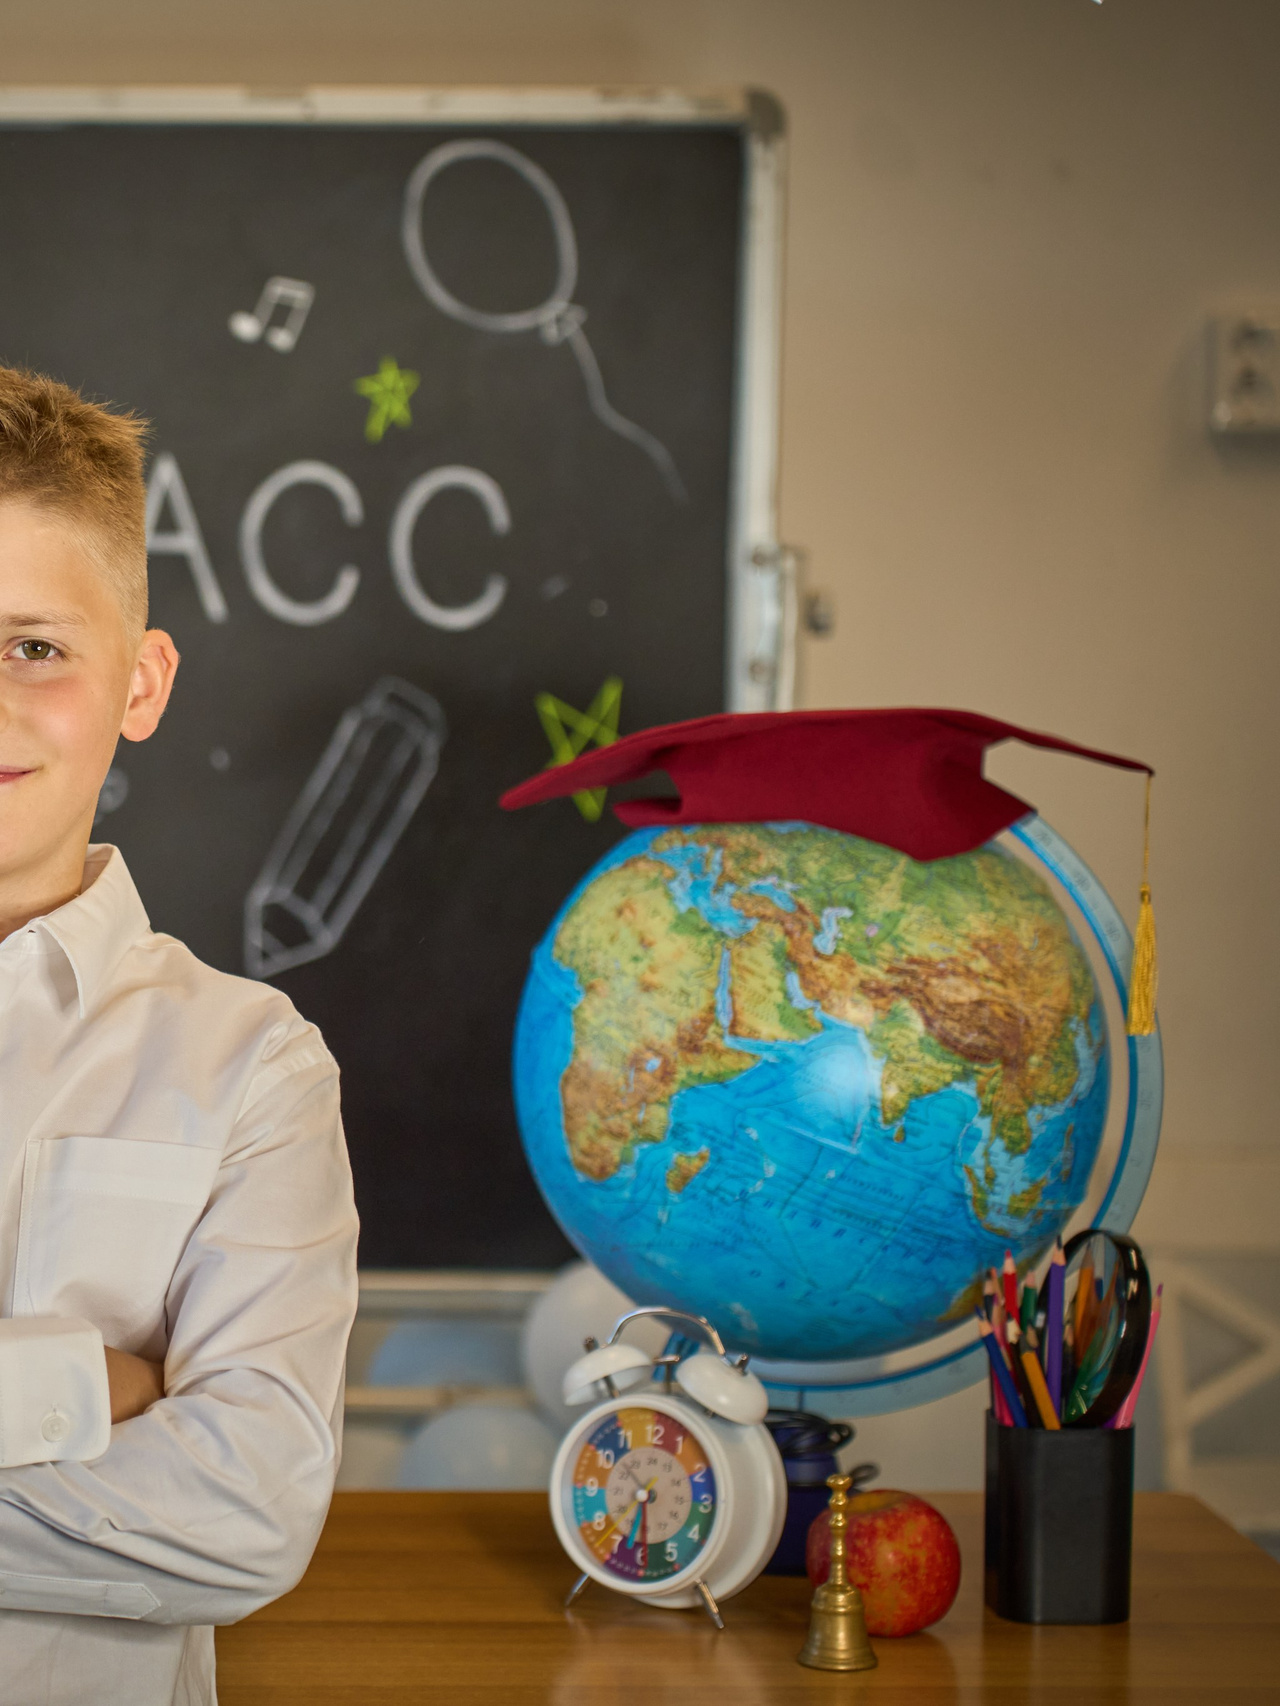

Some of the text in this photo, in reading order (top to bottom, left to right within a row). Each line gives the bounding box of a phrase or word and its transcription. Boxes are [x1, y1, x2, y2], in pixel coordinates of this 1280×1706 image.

[145, 452, 511, 631] АСС
[618, 1429, 632, 1449] 11
[645, 1424, 665, 1445] 12
[676, 1435, 684, 1455] 1
[597, 1449, 615, 1469] 10
[692, 1463, 707, 1483] 2
[585, 1477, 598, 1497] 9
[698, 1493, 713, 1513] 3
[593, 1510, 606, 1531] 8
[687, 1524, 700, 1543] 4
[611, 1534, 623, 1554] 7
[665, 1543, 678, 1562] 5
